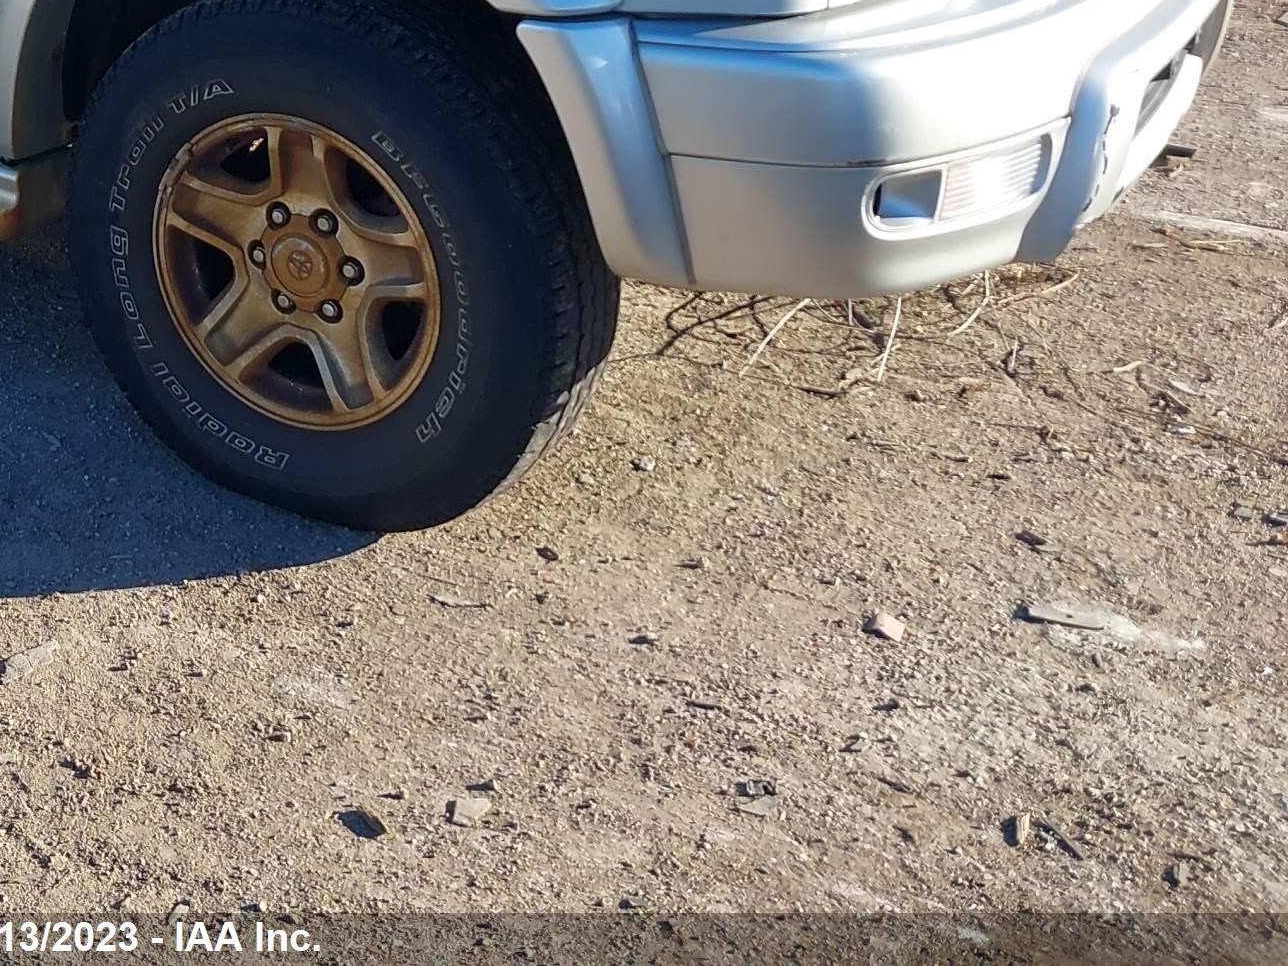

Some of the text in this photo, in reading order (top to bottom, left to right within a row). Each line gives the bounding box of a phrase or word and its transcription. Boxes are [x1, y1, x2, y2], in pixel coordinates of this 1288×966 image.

[108, 78, 290, 471] Radial Long Trail T/A
